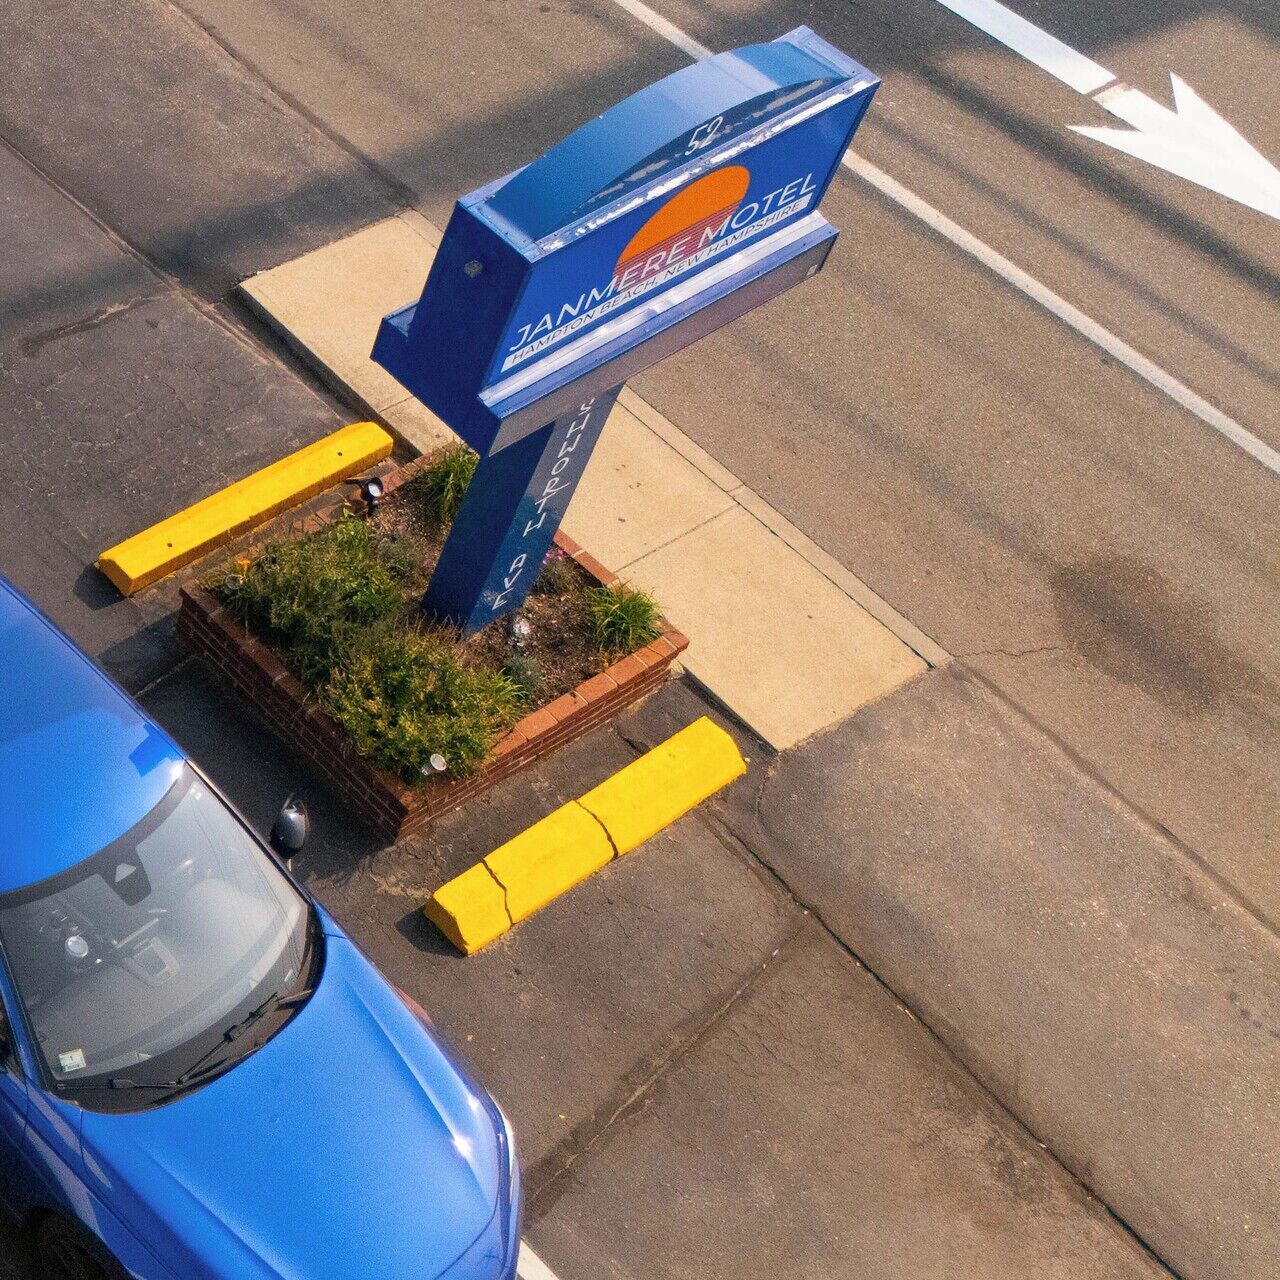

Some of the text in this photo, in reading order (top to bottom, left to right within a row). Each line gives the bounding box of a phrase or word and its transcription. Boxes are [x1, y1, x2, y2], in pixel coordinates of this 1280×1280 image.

[684, 116, 723, 156] 52
[509, 173, 816, 351] JANMERE MOTEL
[511, 199, 802, 363] HAMPTON BEACH, NEW HAMPSHIRE
[491, 554, 527, 611] AVE
